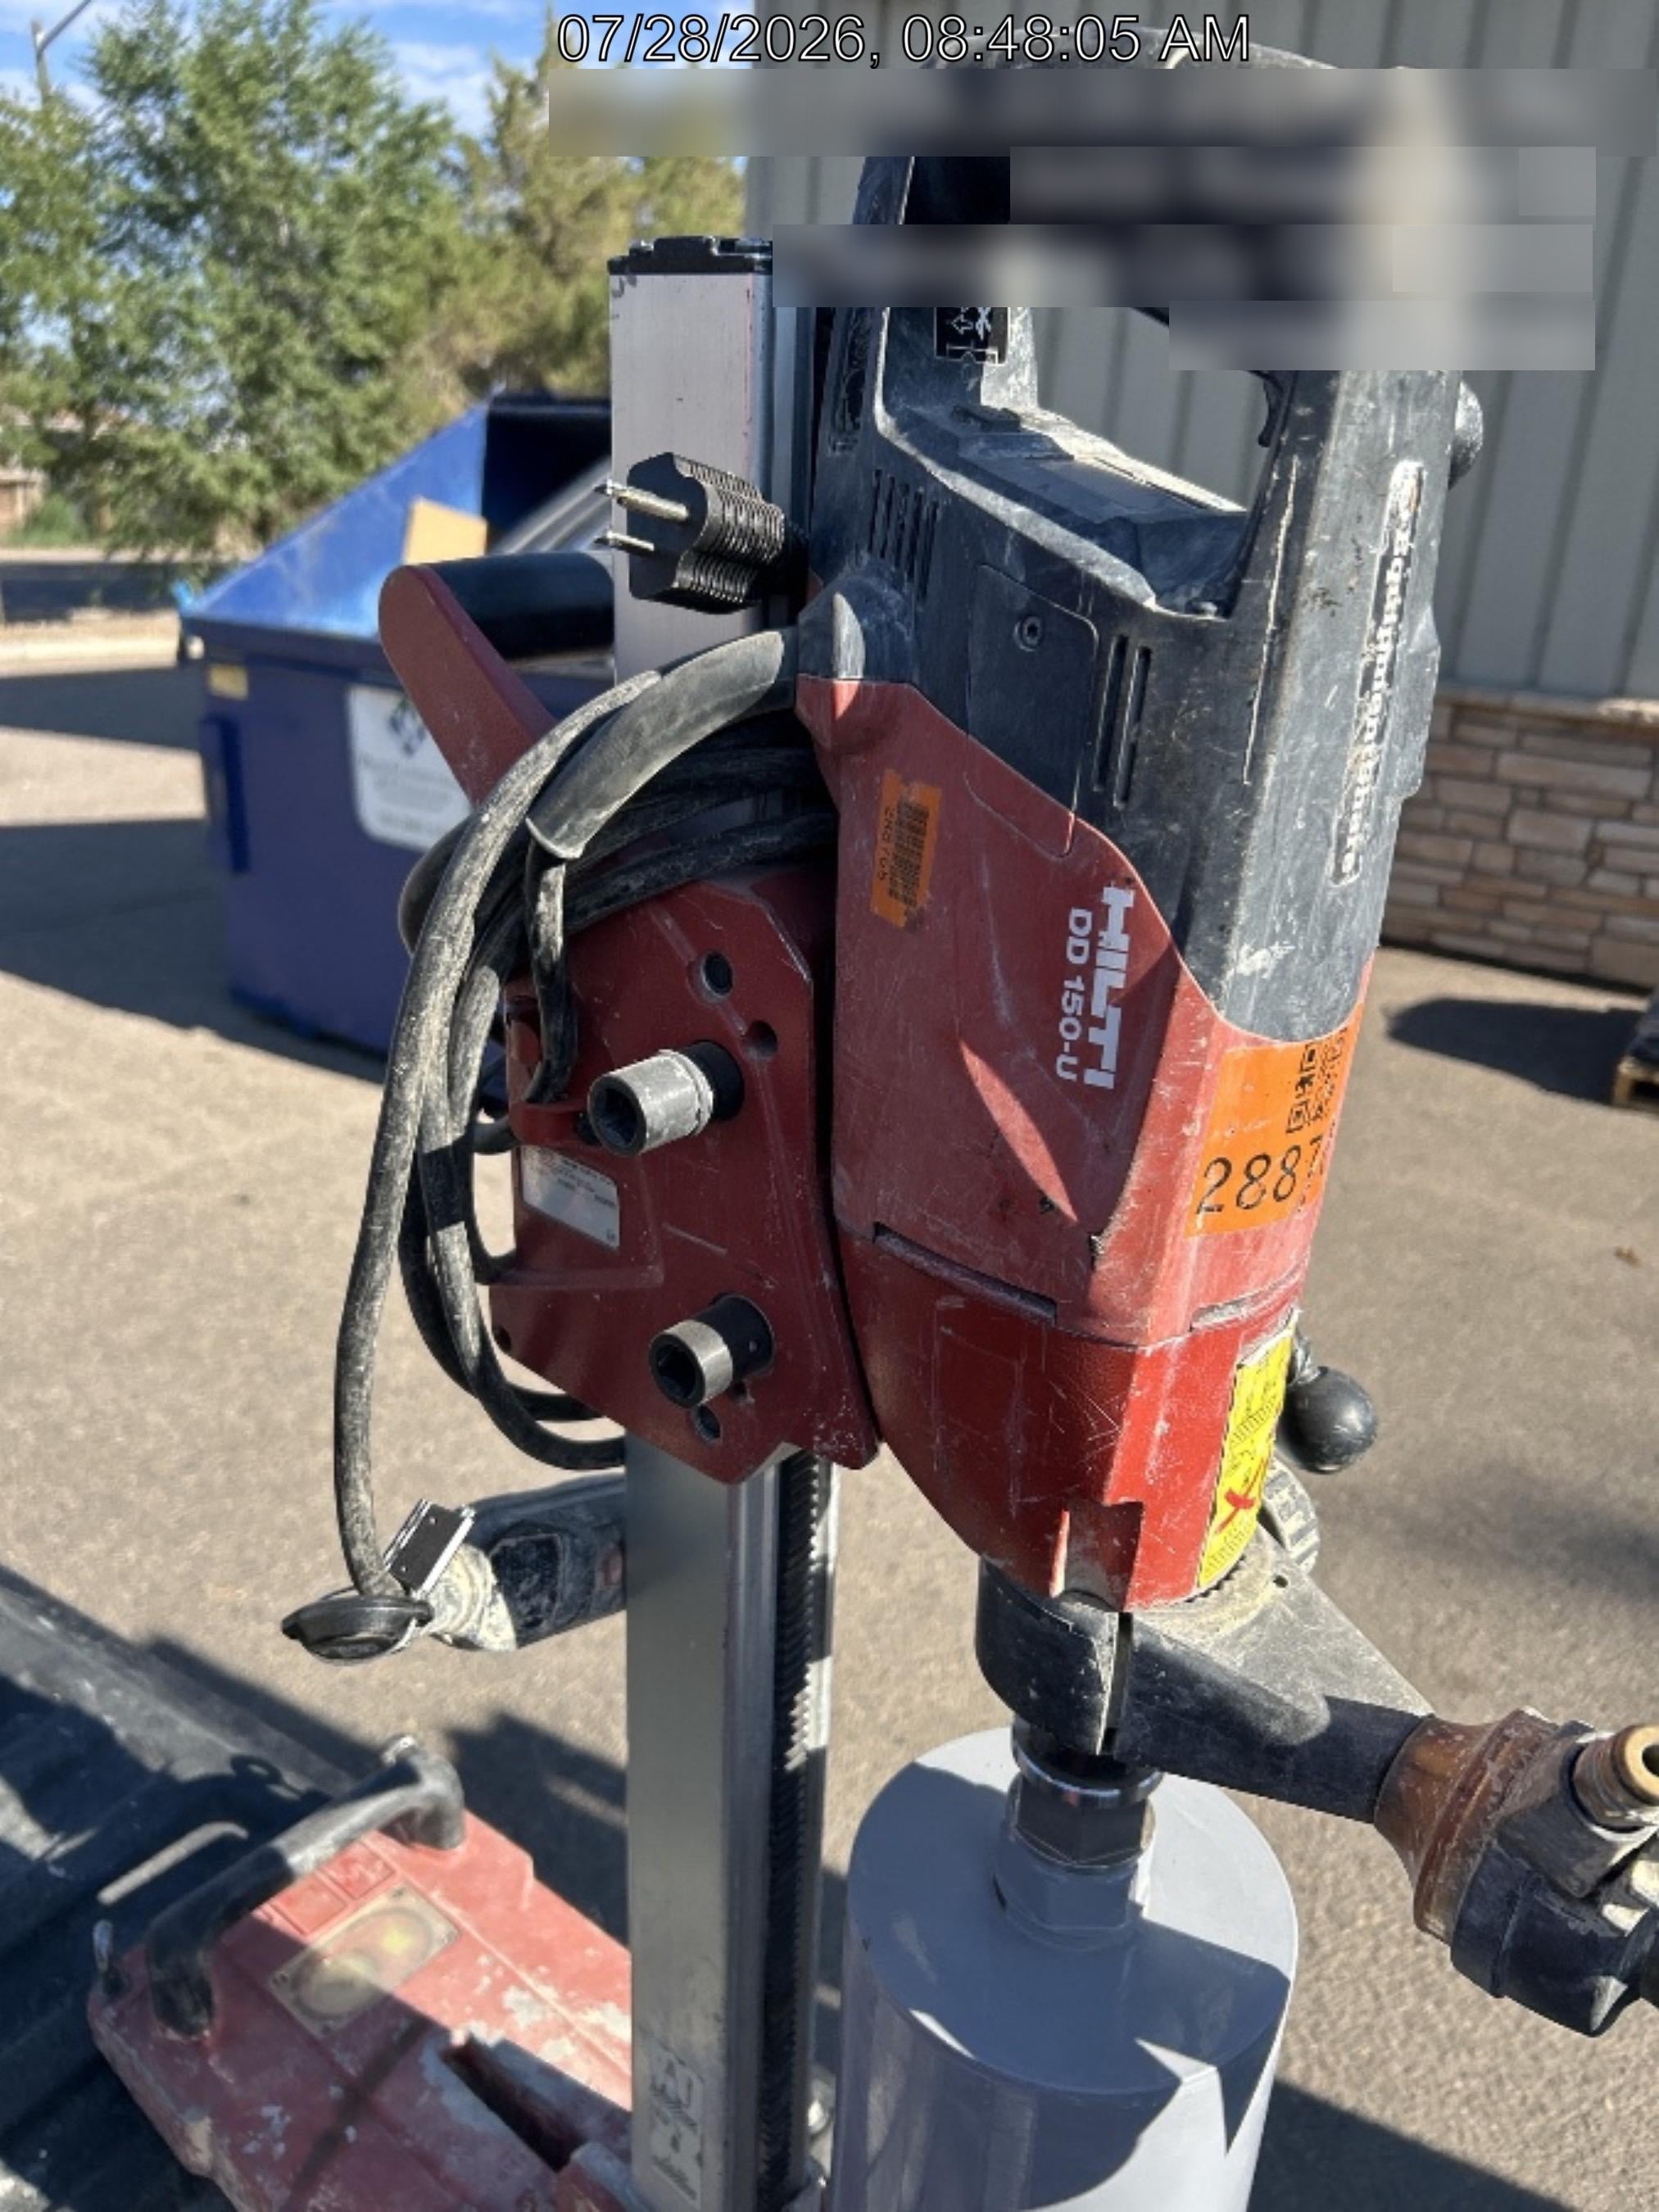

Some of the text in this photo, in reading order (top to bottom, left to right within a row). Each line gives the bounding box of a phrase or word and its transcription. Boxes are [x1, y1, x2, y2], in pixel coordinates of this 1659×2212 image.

[1055, 907, 1093, 1082] DD 150-U
[1084, 886, 1135, 1090] HILTI
